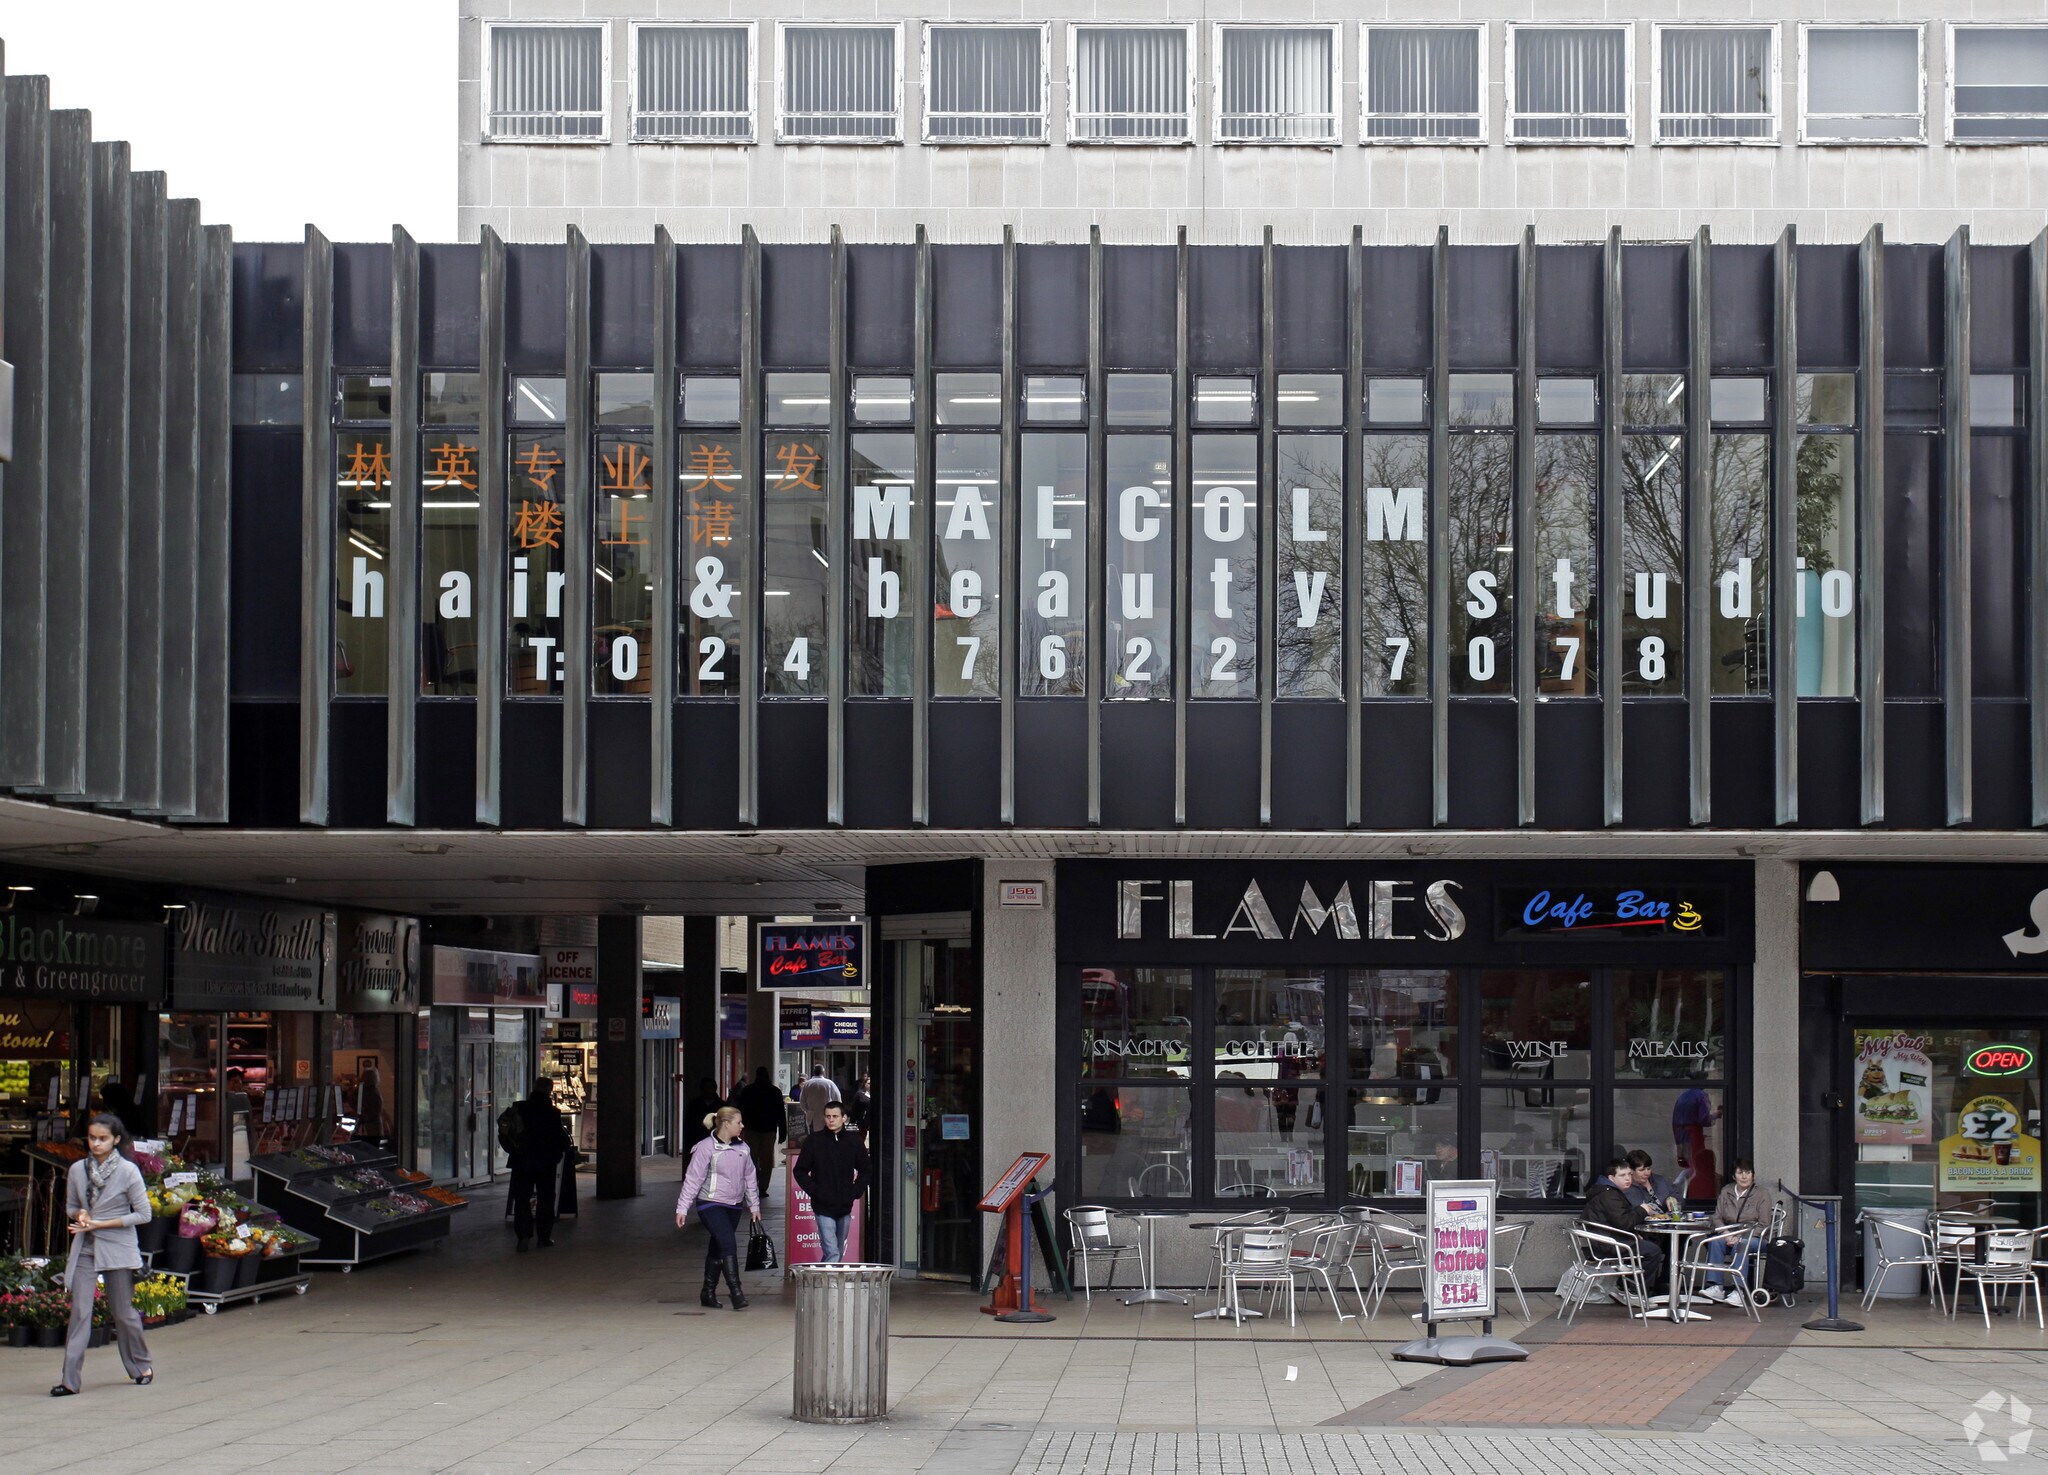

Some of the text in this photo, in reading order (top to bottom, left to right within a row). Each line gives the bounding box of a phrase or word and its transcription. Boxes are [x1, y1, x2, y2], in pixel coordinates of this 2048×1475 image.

[513, 499, 735, 550] 楼上请
[853, 485, 1424, 542] MALCOLM
[351, 555, 1854, 628] hair & beauty studio
[955, 635, 1239, 682] 7622
[1384, 636, 1667, 682] 7078
[1010, 887, 1035, 895] JSB
[1117, 877, 1466, 942] FLAMES
[1522, 889, 1671, 928] Cafe Bar
[765, 935, 856, 951] FLAMES
[556, 951, 579, 963] OFF
[770, 950, 848, 976] Cafe Bar
[15, 965, 26, 988] &
[36, 965, 146, 997] Greengrocer
[1092, 1039, 1183, 1057] SNACKS
[1224, 1039, 1317, 1057] COFFEE
[1506, 1040, 1568, 1059] WINE
[1628, 1040, 1710, 1058] MEALS
[1859, 1038, 1891, 1061] My
[1893, 1033, 1925, 1050] Sub
[1909, 1053, 1927, 1065] Way
[1975, 1051, 2025, 1068] OPEN
[1961, 1110, 2018, 1141] £2
[1947, 1167, 1974, 1175] BACON
[1975, 1167, 1991, 1175] SUB
[2000, 1167, 2007, 1175] A
[2008, 1167, 2033, 1175] DRINK
[1433, 1226, 1488, 1250] Take Away
[1434, 1249, 1487, 1273] Coffee
[1441, 1282, 1479, 1305] £1.54
